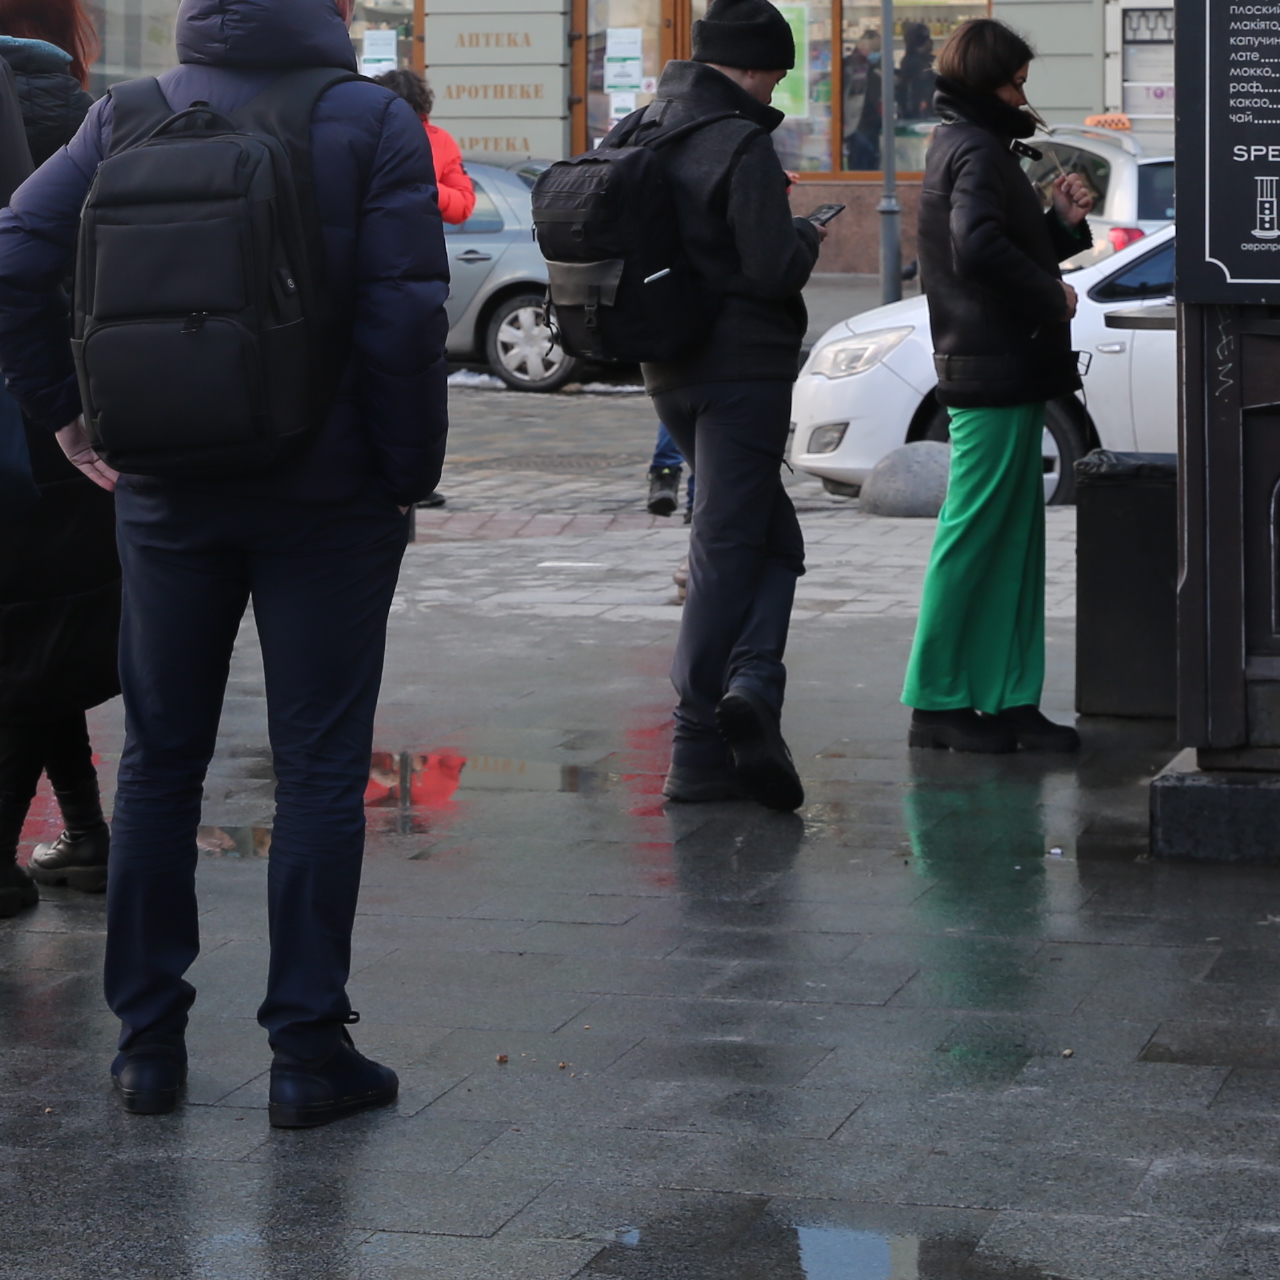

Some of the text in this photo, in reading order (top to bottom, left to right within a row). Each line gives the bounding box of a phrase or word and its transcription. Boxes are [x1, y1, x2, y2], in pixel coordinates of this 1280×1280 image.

[1229, 18, 1279, 30] макіято
[1229, 52, 1260, 61] лате
[1229, 67, 1271, 76] мокко
[442, 84, 545, 100] APOTHEKE
[1229, 81, 1261, 94] раф
[1229, 98, 1269, 108] какао
[1228, 111, 1253, 123] чай
